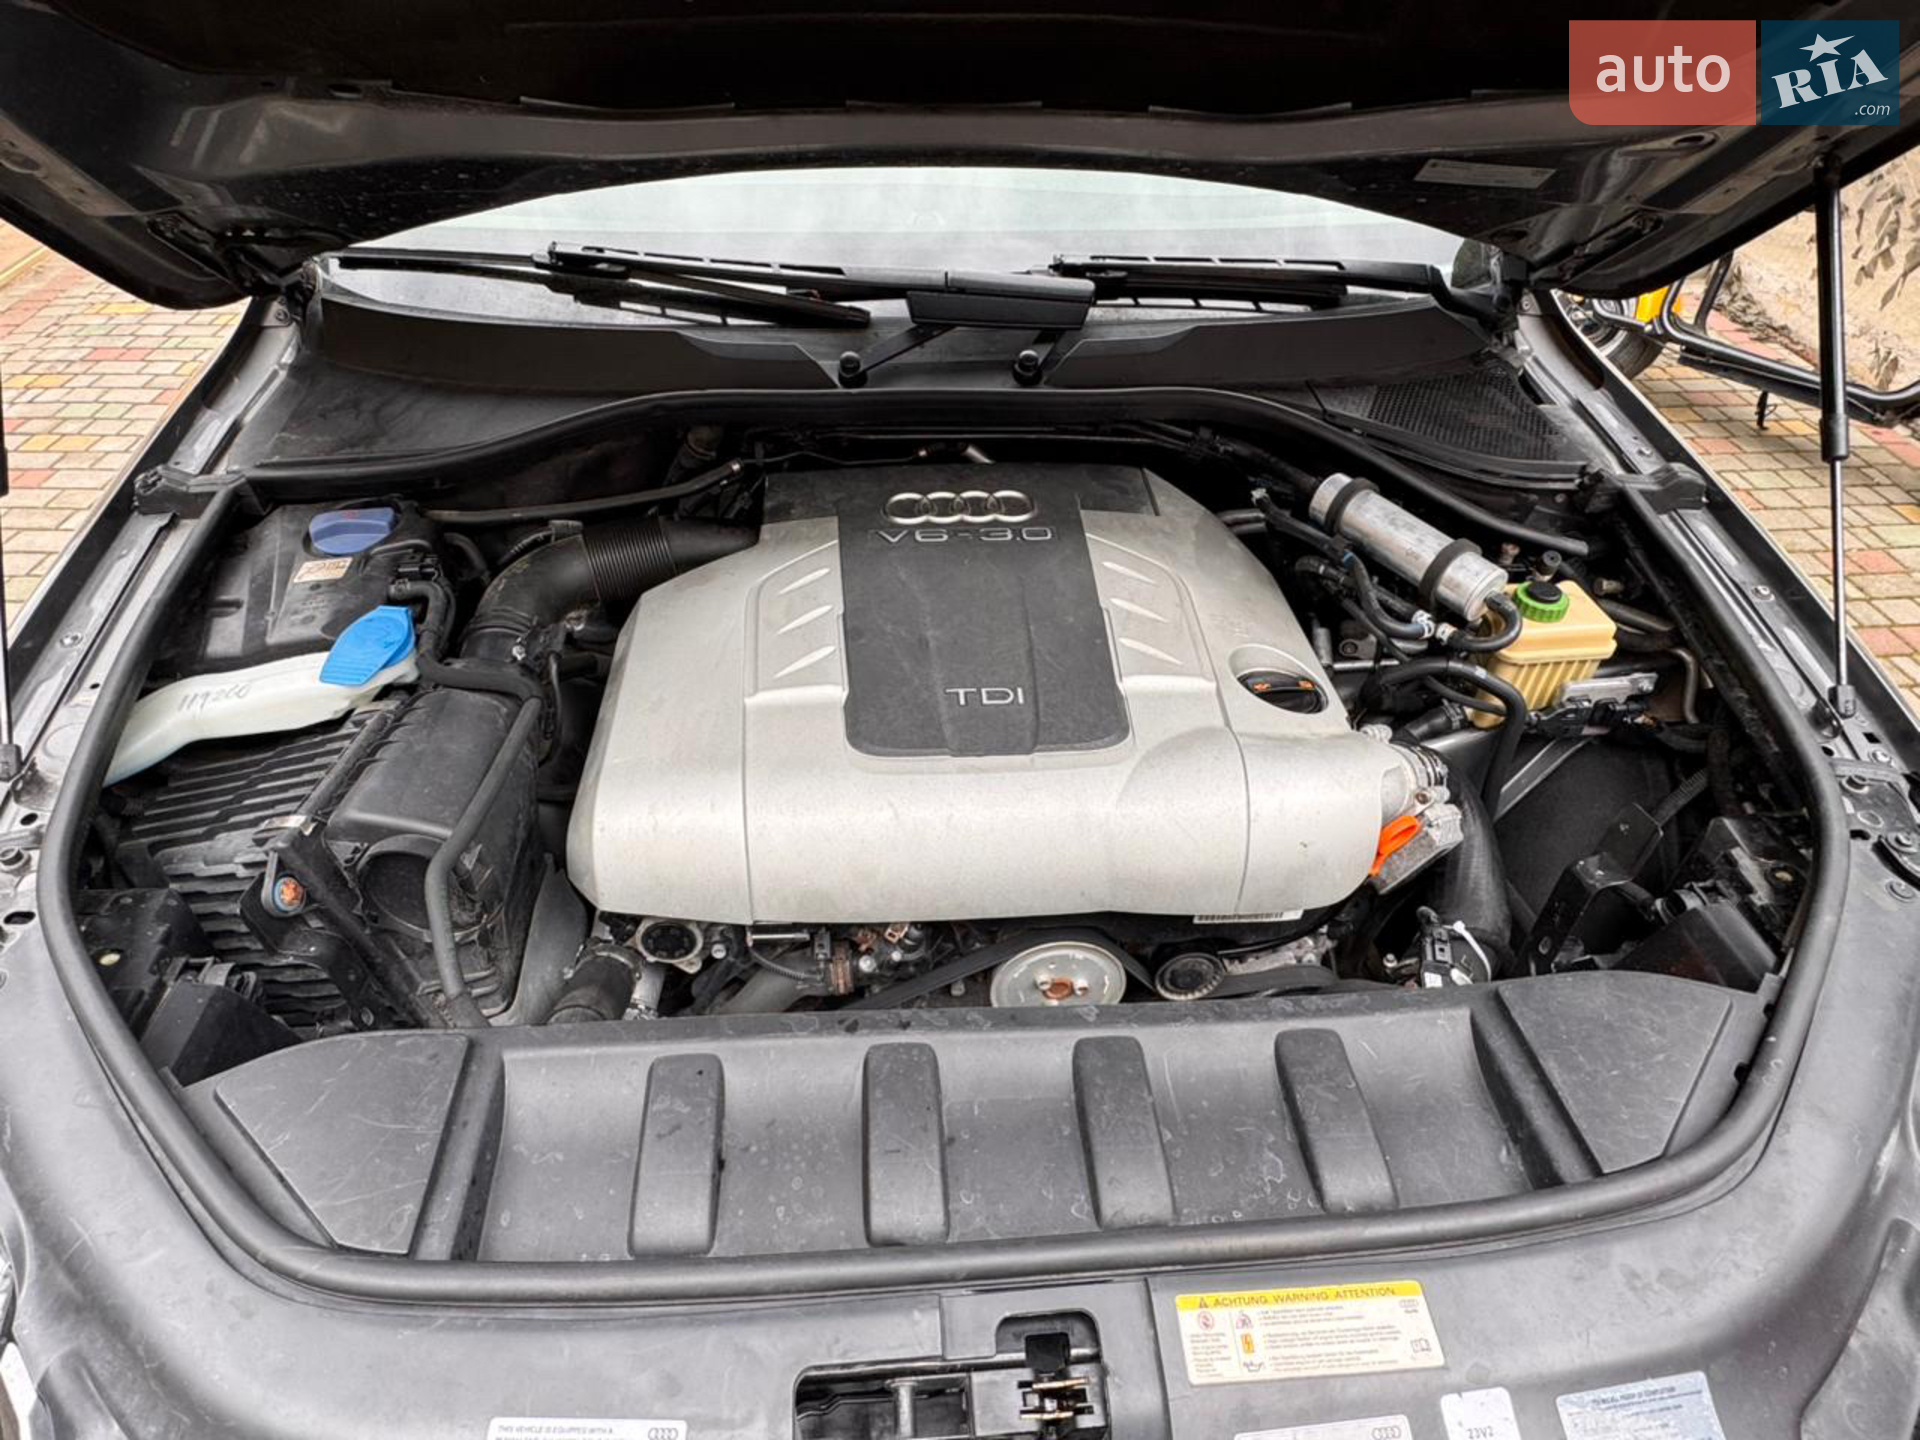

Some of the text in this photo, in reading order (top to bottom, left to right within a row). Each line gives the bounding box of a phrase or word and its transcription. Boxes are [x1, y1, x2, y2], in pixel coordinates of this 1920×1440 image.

[945, 687, 1025, 706] TDI
[1213, 1286, 1396, 1308] ACHTUNG WARNING ATTENTION
